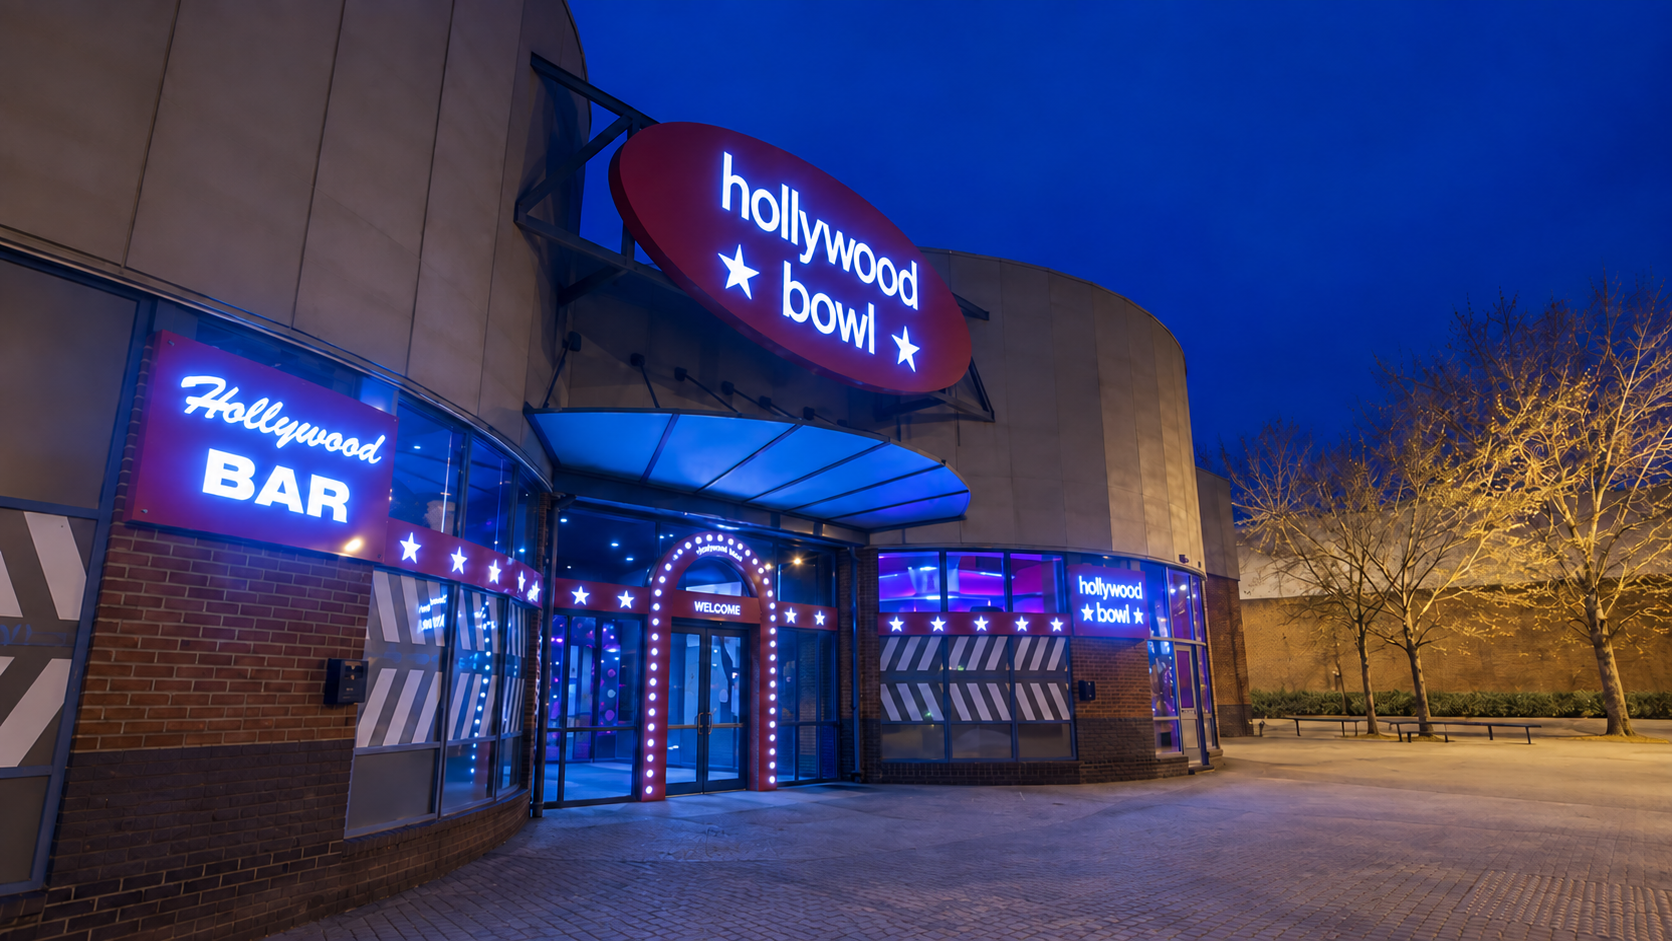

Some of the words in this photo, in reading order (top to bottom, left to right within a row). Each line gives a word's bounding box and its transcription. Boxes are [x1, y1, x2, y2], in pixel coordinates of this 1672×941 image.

[722, 151, 918, 311] hollywood
[783, 260, 875, 355] bowl
[180, 375, 386, 464] Hollywood
[202, 448, 349, 523] BAR
[694, 601, 741, 615] WELCOME
[1078, 575, 1143, 600] hollywood
[1096, 602, 1131, 624] bowl
